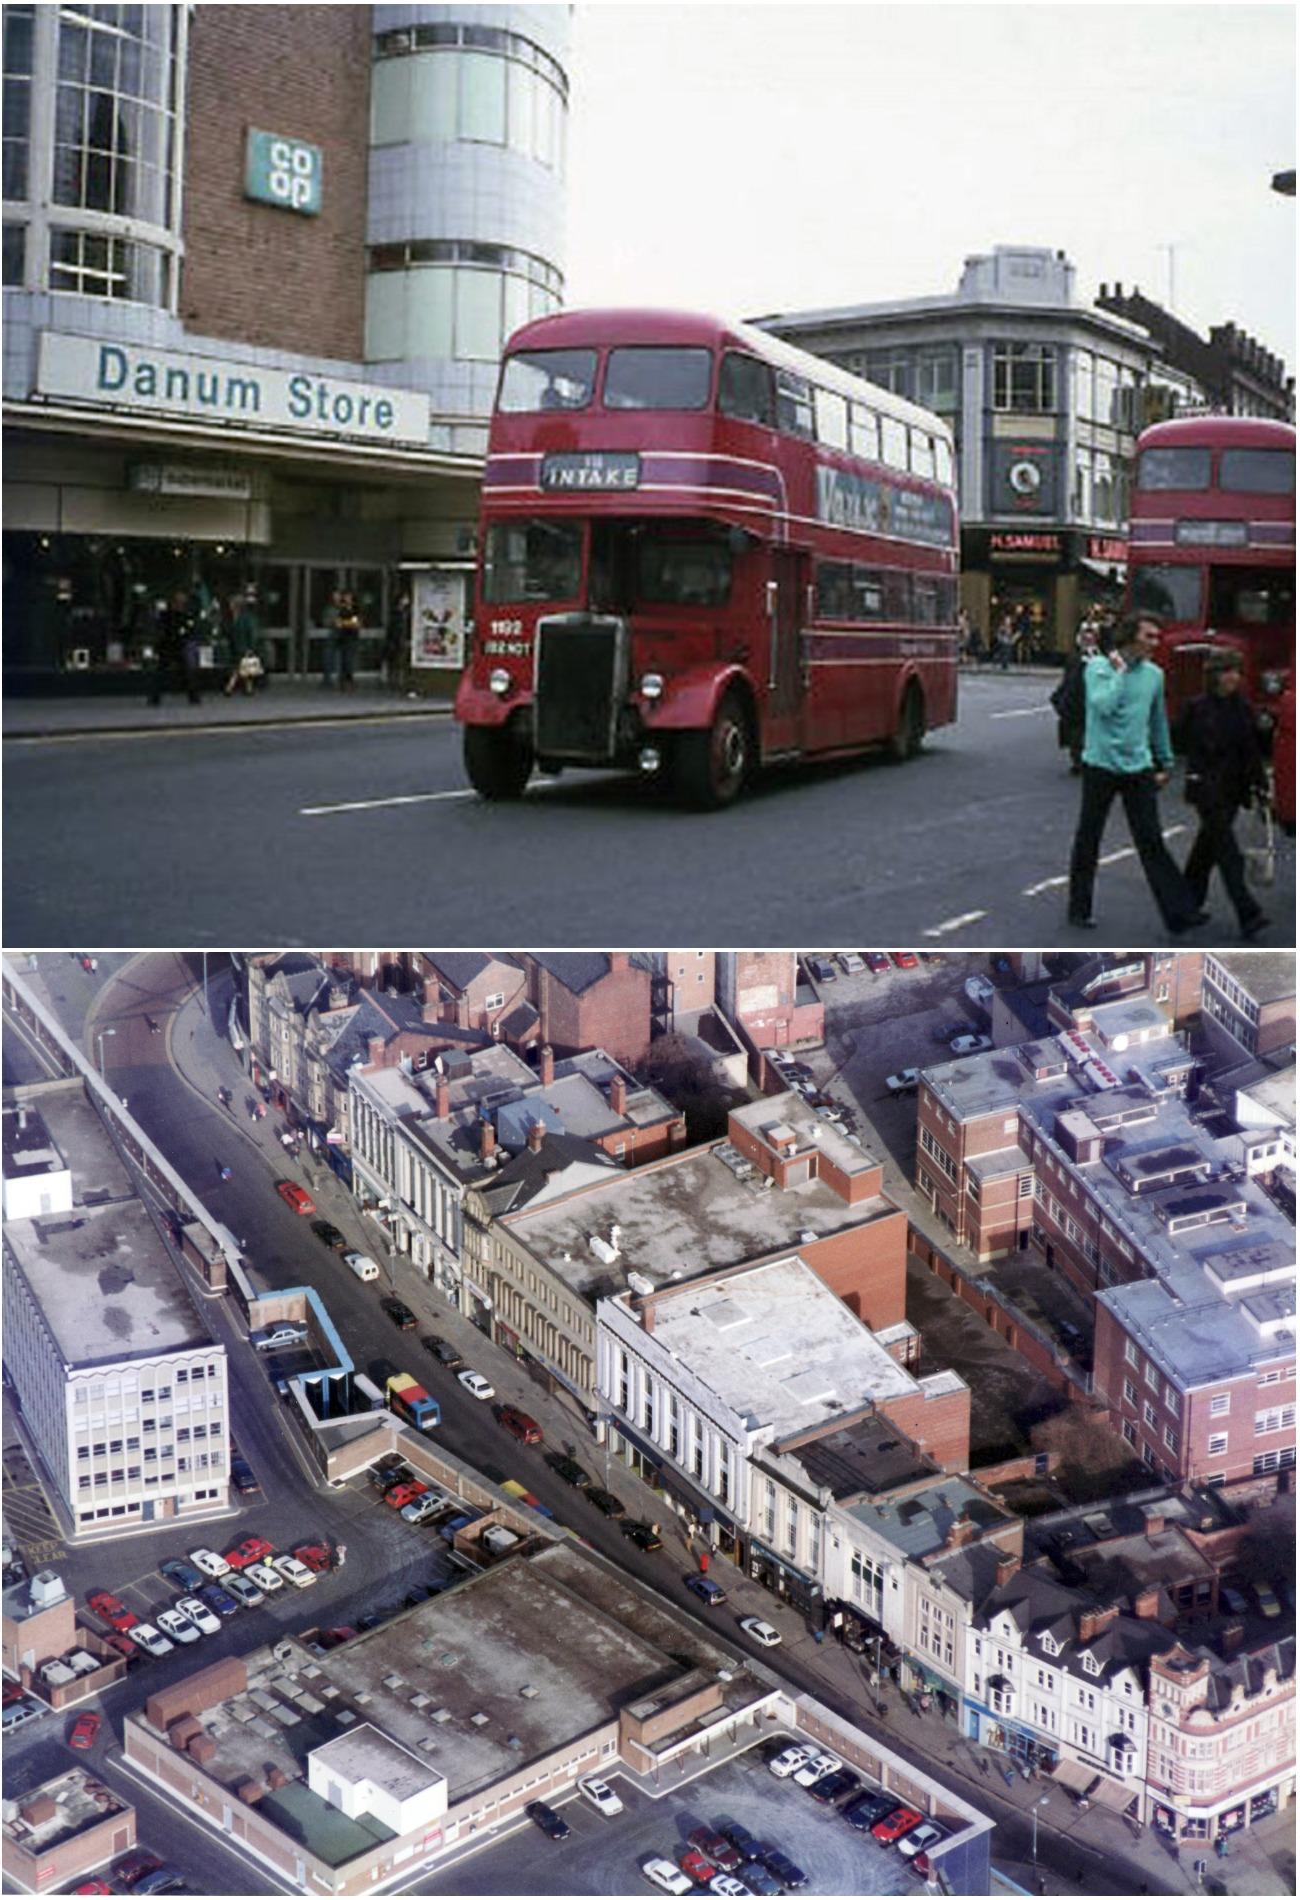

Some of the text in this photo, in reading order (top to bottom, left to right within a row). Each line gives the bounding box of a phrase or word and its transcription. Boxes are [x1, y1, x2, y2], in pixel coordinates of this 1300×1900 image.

[97, 346, 394, 429] Danum Store
[548, 466, 638, 486] INTAKE
